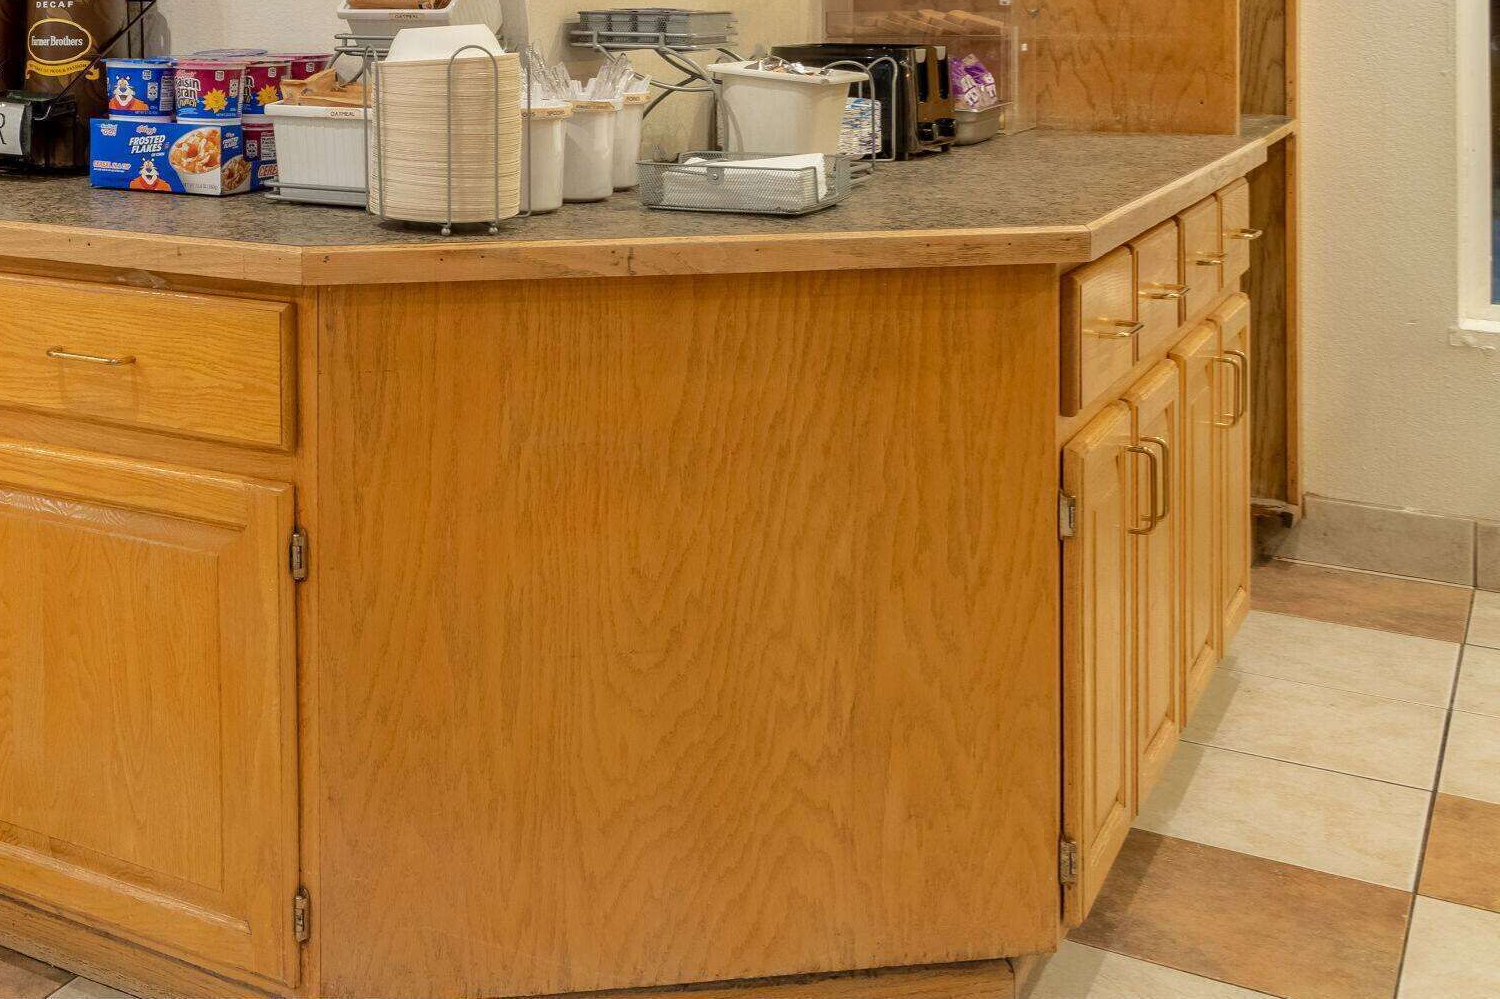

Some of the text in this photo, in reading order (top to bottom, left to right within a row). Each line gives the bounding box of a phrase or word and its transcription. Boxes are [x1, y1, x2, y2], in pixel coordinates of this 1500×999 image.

[50, 35, 83, 46] Brothers
[129, 135, 166, 146] FROSTED
[131, 143, 163, 154] FLAKES
